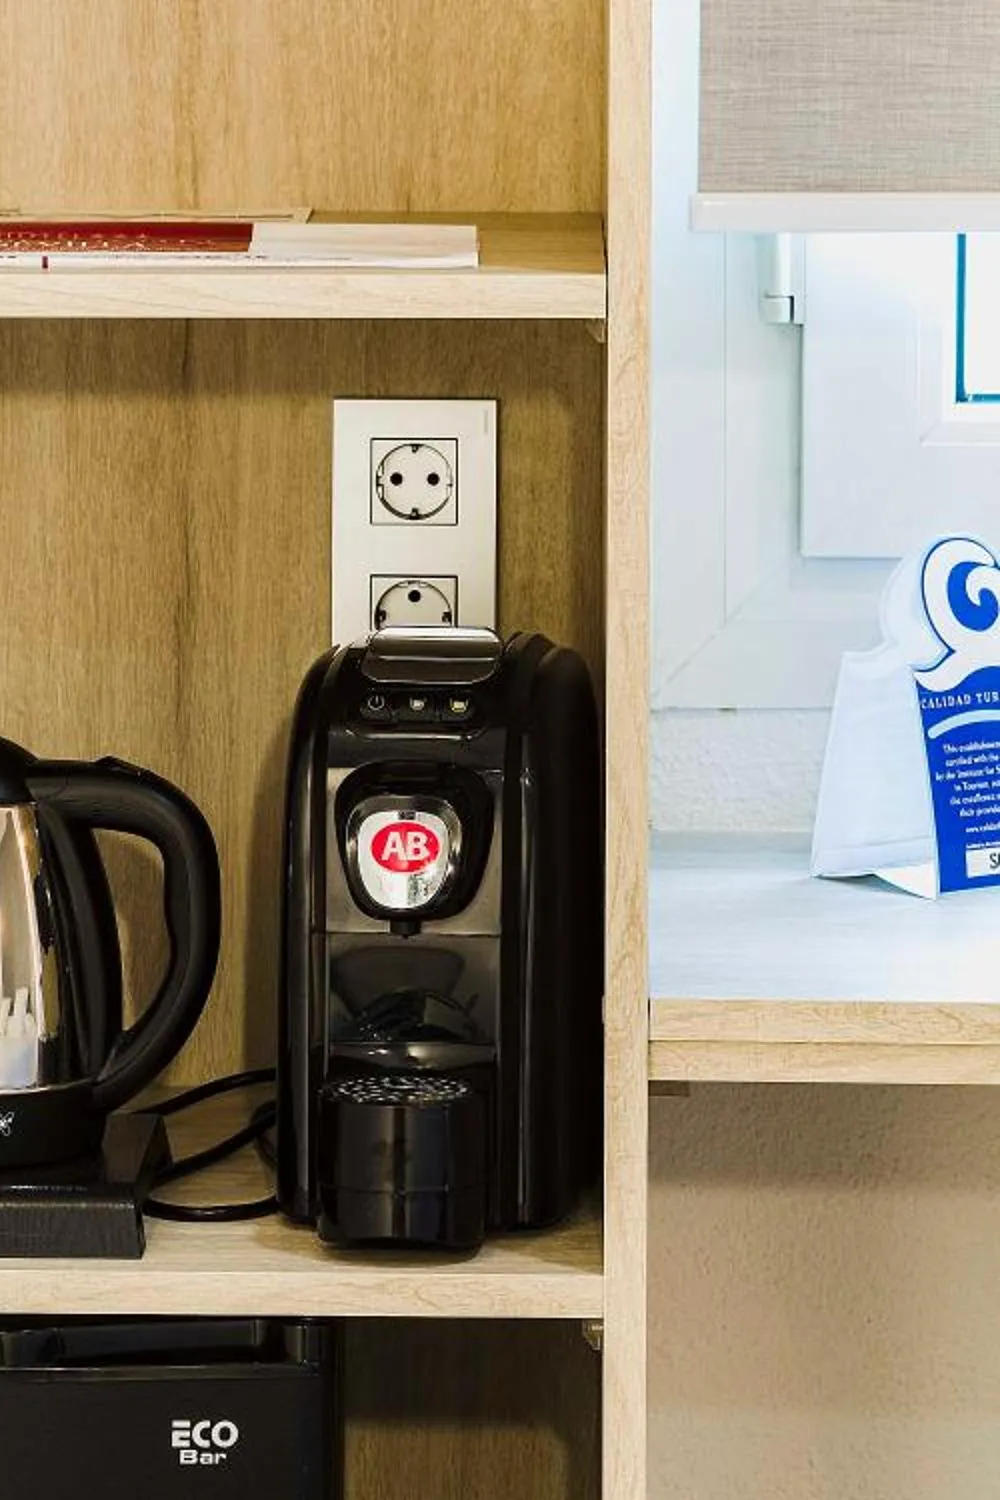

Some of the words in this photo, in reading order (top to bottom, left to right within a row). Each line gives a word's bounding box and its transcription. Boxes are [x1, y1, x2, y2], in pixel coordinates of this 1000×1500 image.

[921, 694, 971, 709] CALIDAD
[381, 831, 430, 861] AB
[171, 1420, 239, 1448] ECO
[179, 1449, 227, 1465] Bar
